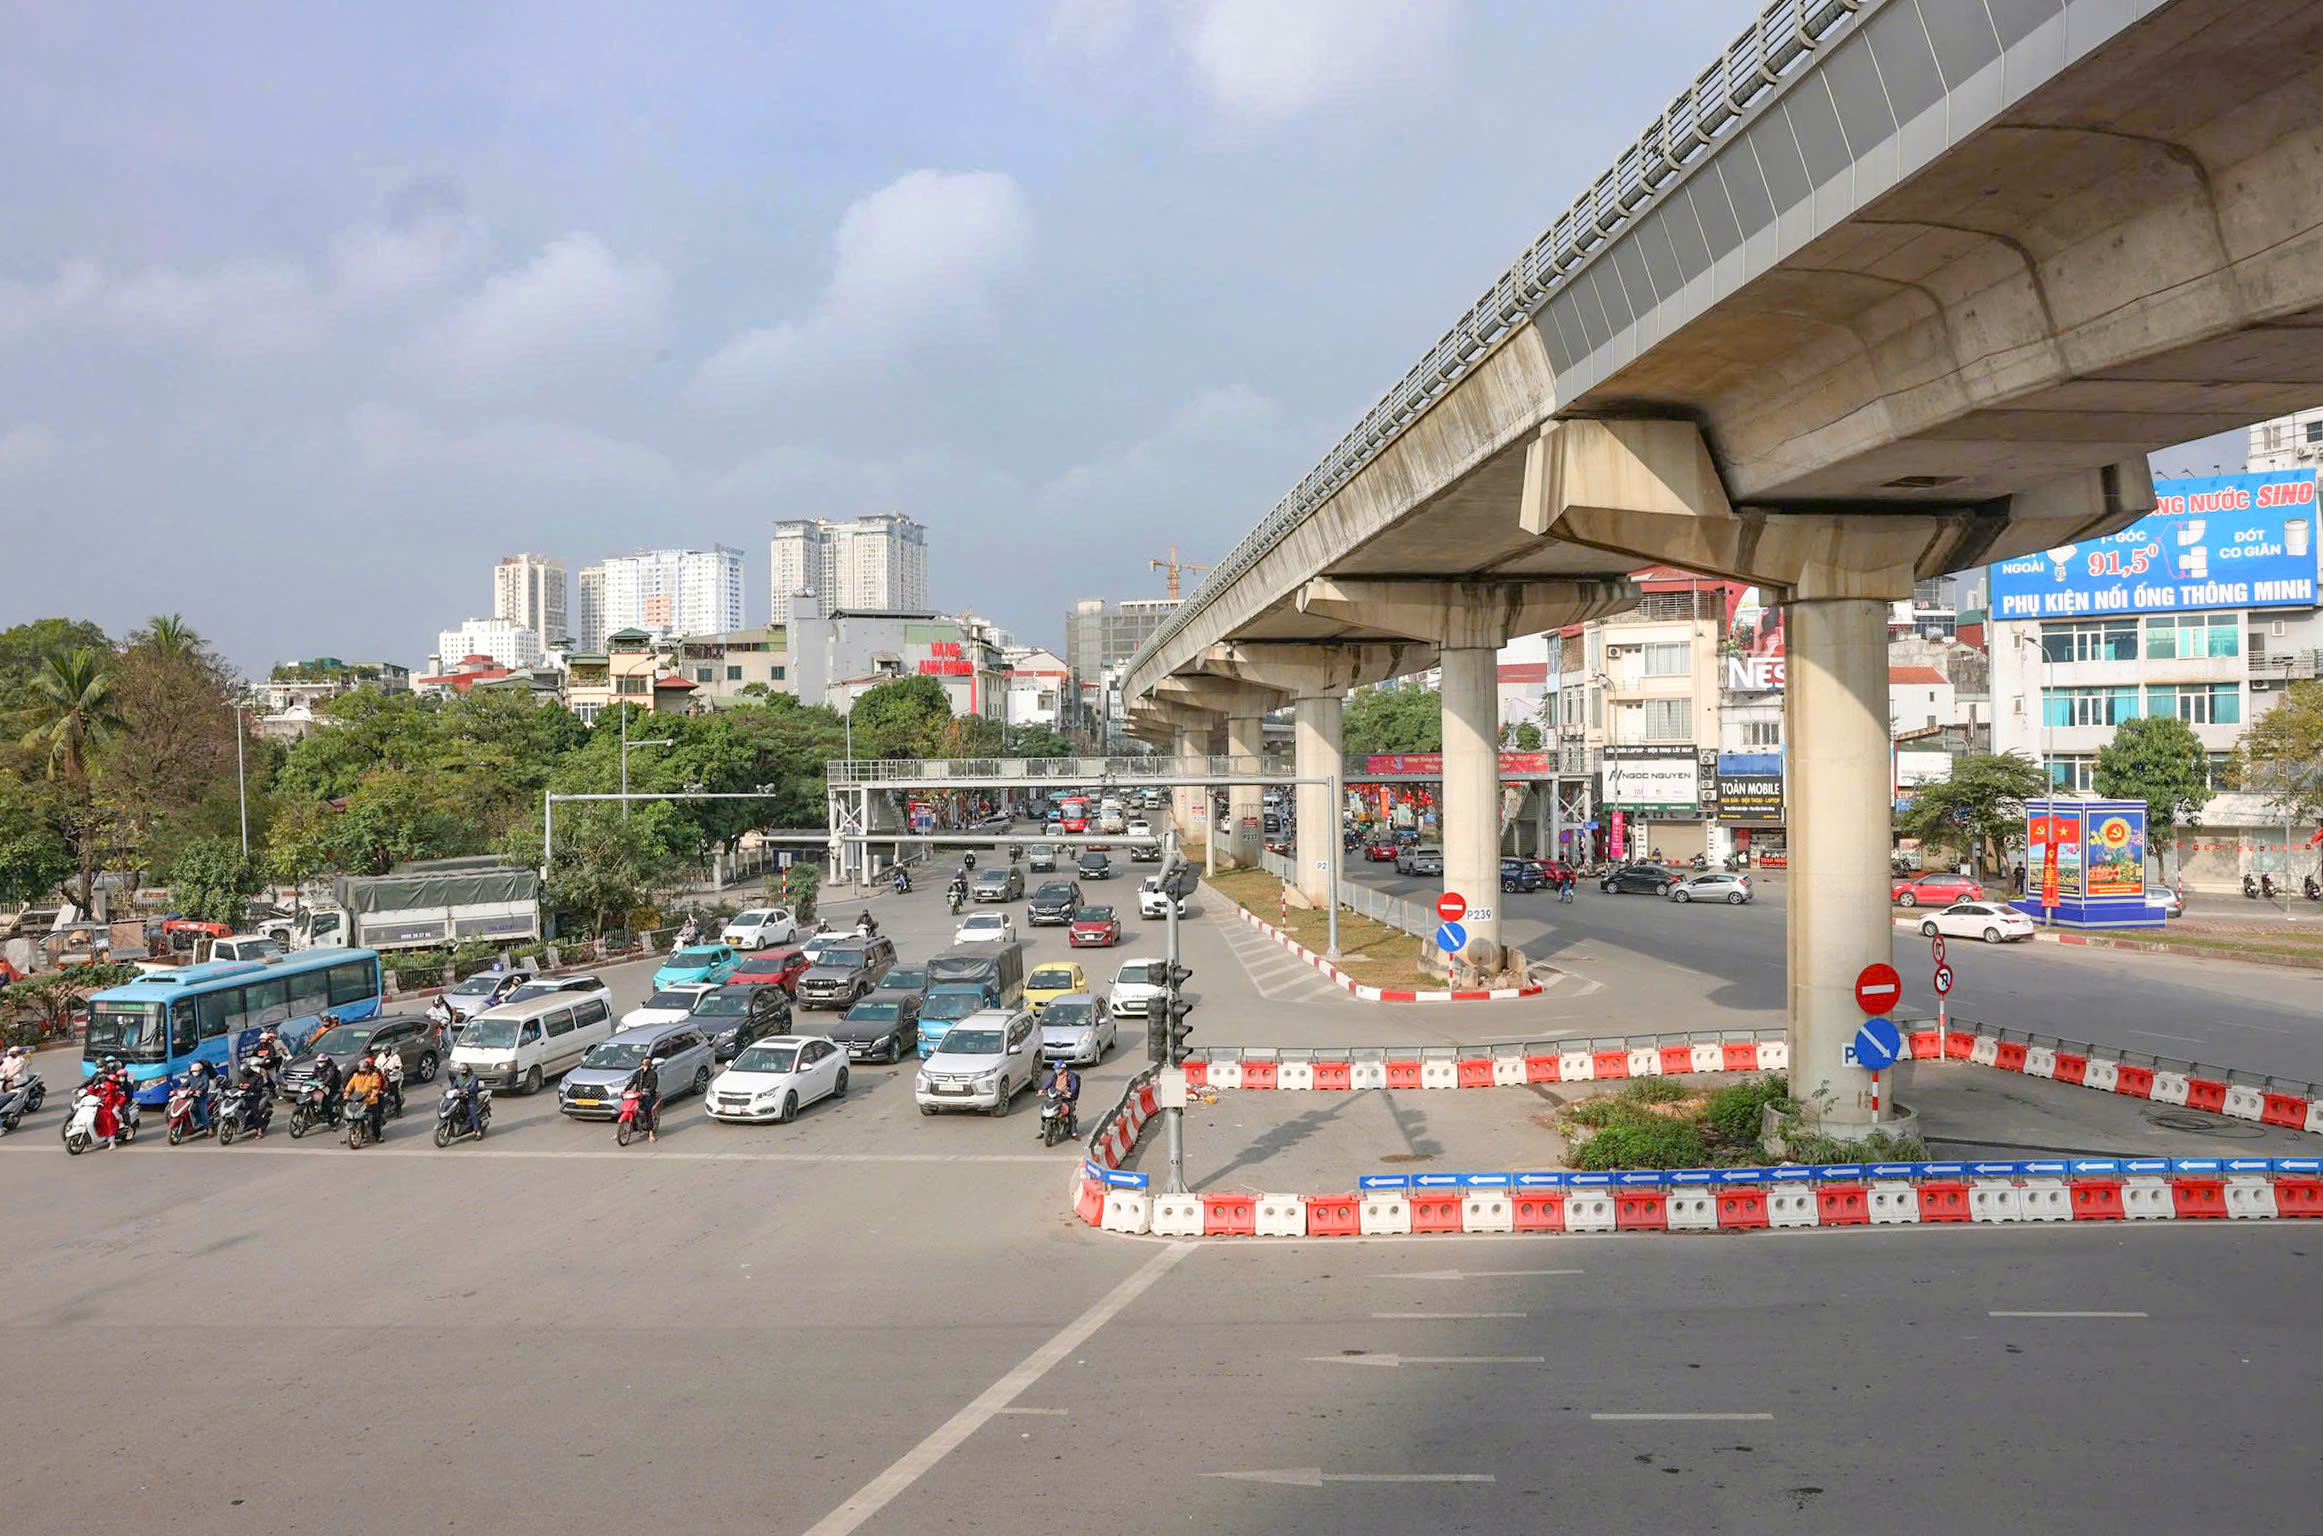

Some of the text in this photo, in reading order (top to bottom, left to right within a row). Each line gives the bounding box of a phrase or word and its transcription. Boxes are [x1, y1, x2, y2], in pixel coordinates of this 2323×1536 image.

[2153, 482, 2315, 516] NG NƯỚC SINO
[2115, 530, 2147, 543] GÓC
[2219, 542, 2281, 559] CO GIÃN
[2002, 561, 2044, 574] NGOÀI
[2003, 579, 2311, 616] PHỤ KIỆN NỐI ỐNG THÔNG MINH
[1650, 772, 1691, 780] NGUYEN
[1721, 779, 1780, 795] TOÀN MOBILE
[1467, 910, 1492, 920] P239
